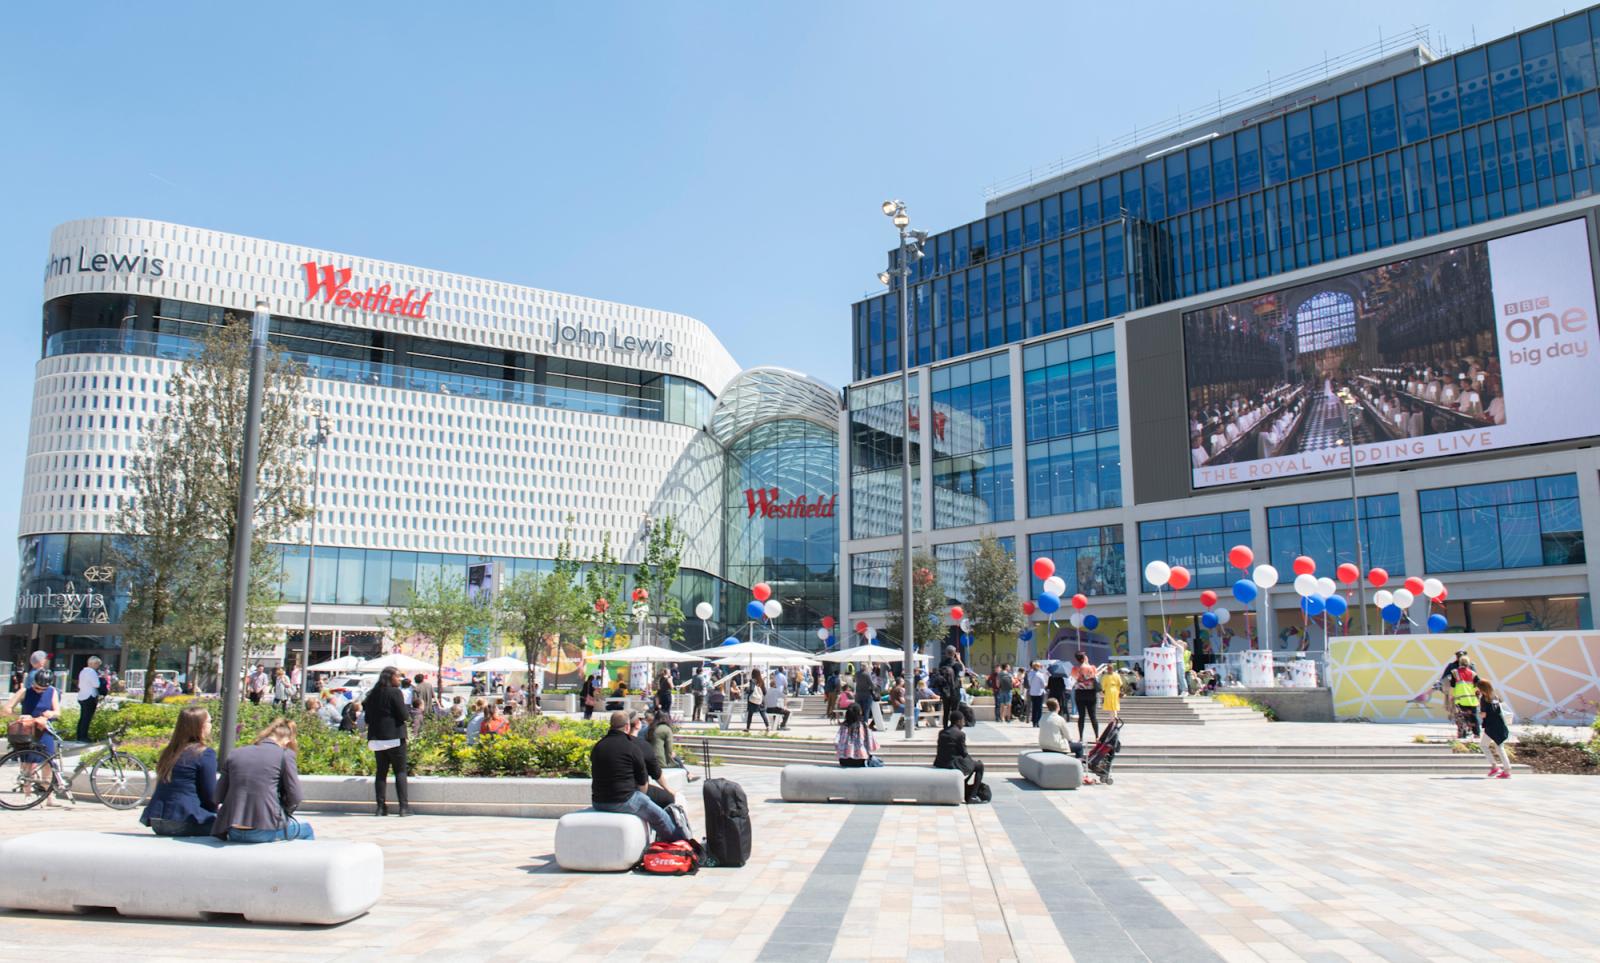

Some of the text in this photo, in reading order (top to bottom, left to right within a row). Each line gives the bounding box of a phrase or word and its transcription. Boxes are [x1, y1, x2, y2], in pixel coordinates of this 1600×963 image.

[78, 246, 164, 276] Lewis
[300, 261, 433, 318] Westfield
[1504, 296, 1550, 316] BBC
[552, 318, 673, 357] John Lewis
[1505, 307, 1588, 343] one
[1509, 340, 1588, 366] big day
[1201, 432, 1492, 482] THE ROYAL WEDDING LIVE
[742, 487, 839, 519] Westfield
[47, 586, 104, 608] Lewis
